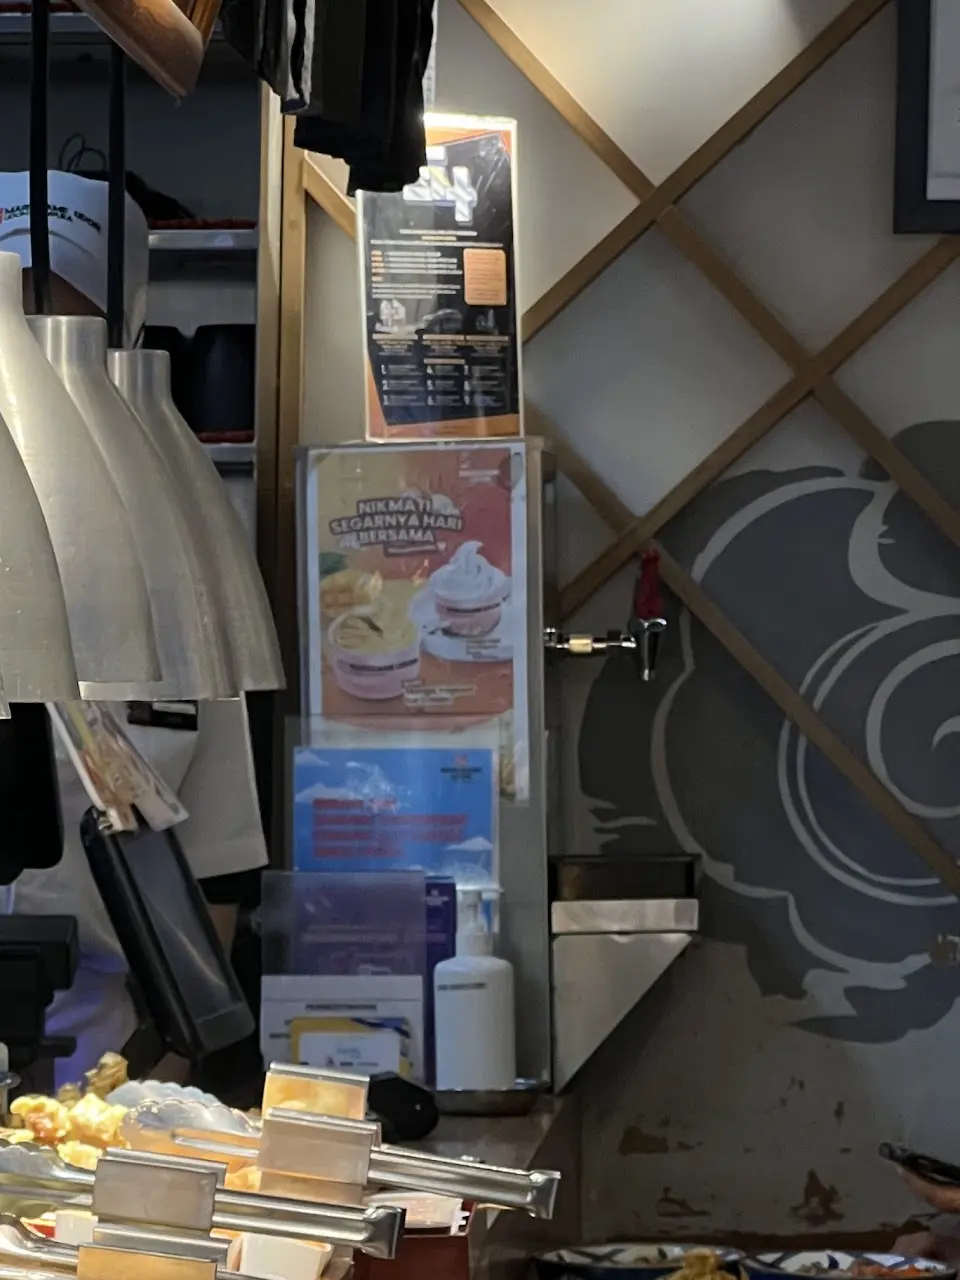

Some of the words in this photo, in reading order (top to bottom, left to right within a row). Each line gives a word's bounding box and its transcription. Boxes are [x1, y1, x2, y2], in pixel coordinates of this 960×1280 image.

[331, 516, 419, 534] SEGARNYA
[423, 514, 462, 530] HARI
[360, 530, 433, 544] BERSAMA
